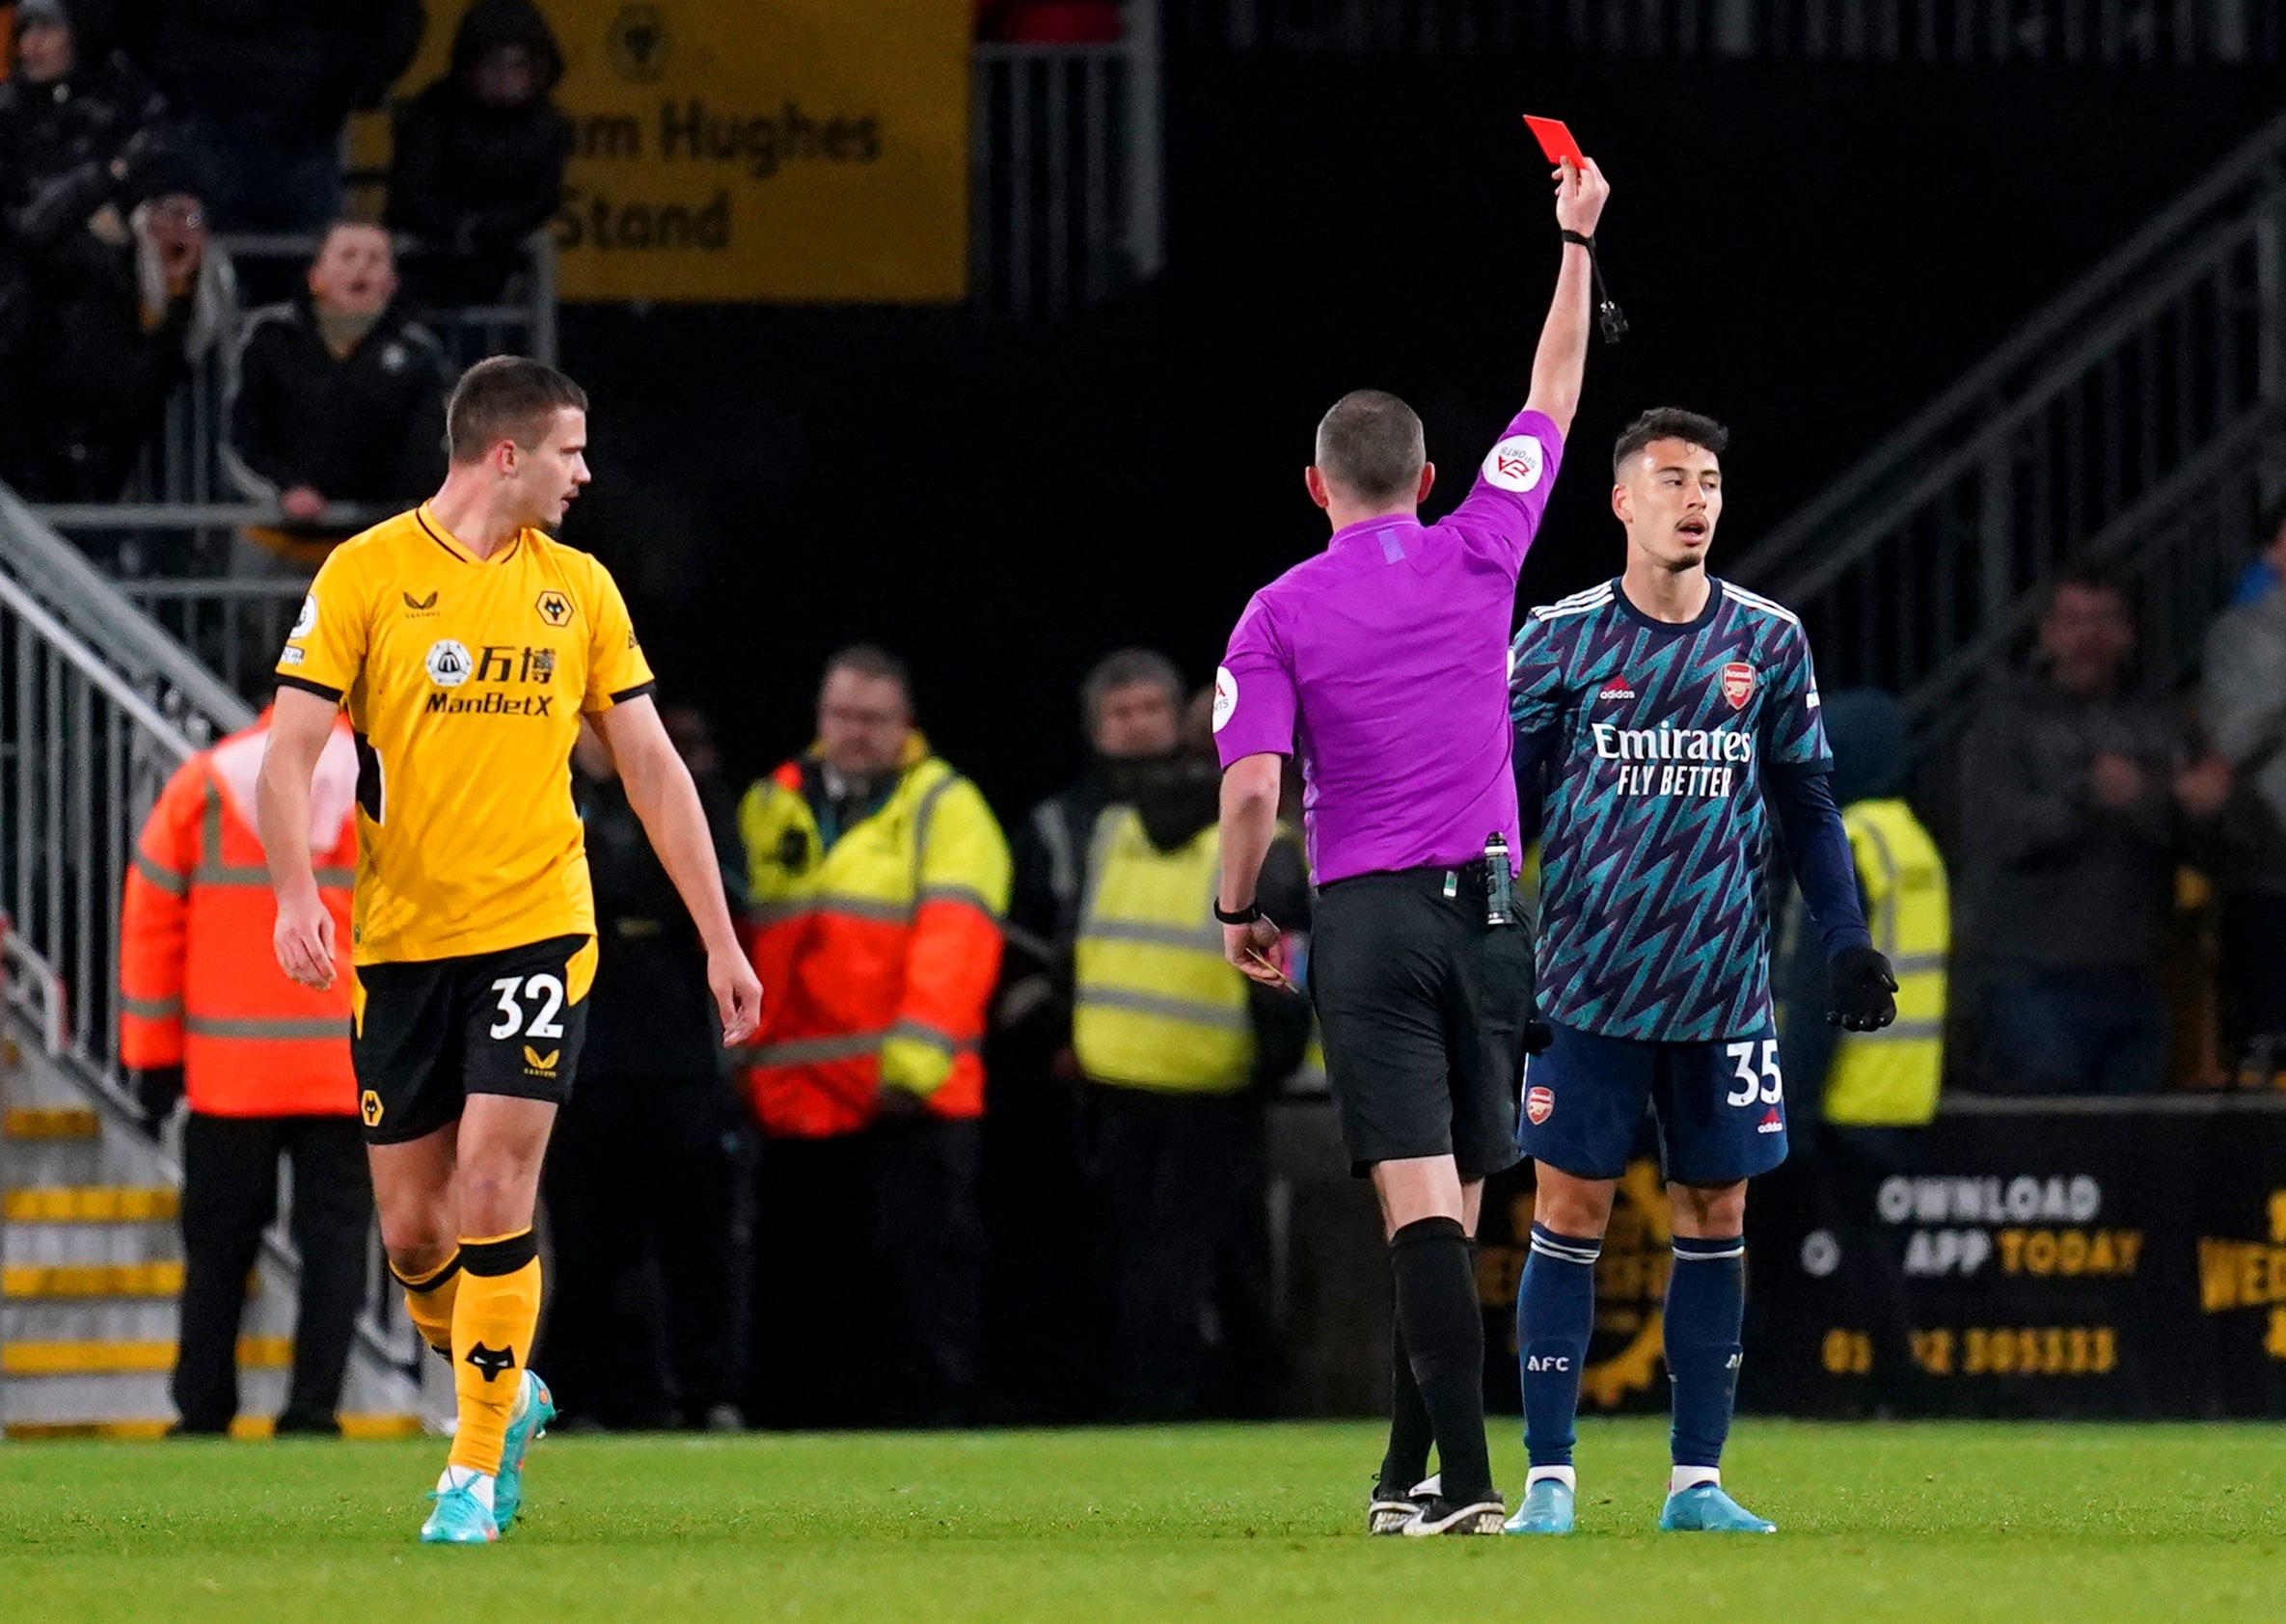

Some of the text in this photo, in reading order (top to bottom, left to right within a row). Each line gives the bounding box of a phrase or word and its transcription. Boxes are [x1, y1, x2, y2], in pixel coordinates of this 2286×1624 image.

[661, 98, 880, 178] Hughes
[557, 189, 732, 249] Stand
[476, 646, 556, 684] 万博
[424, 691, 553, 717] ManBetX
[1599, 690, 1636, 700] adidas
[1592, 721, 1753, 762] Emirates
[1618, 765, 1733, 798] FLY BETTER
[489, 973, 565, 1041] 32
[1726, 1040, 1783, 1107] 35
[1877, 1175, 2101, 1223] OWNLOAD
[1903, 1228, 2144, 1277] APP TODAY
[1526, 1355, 1570, 1372] AFC
